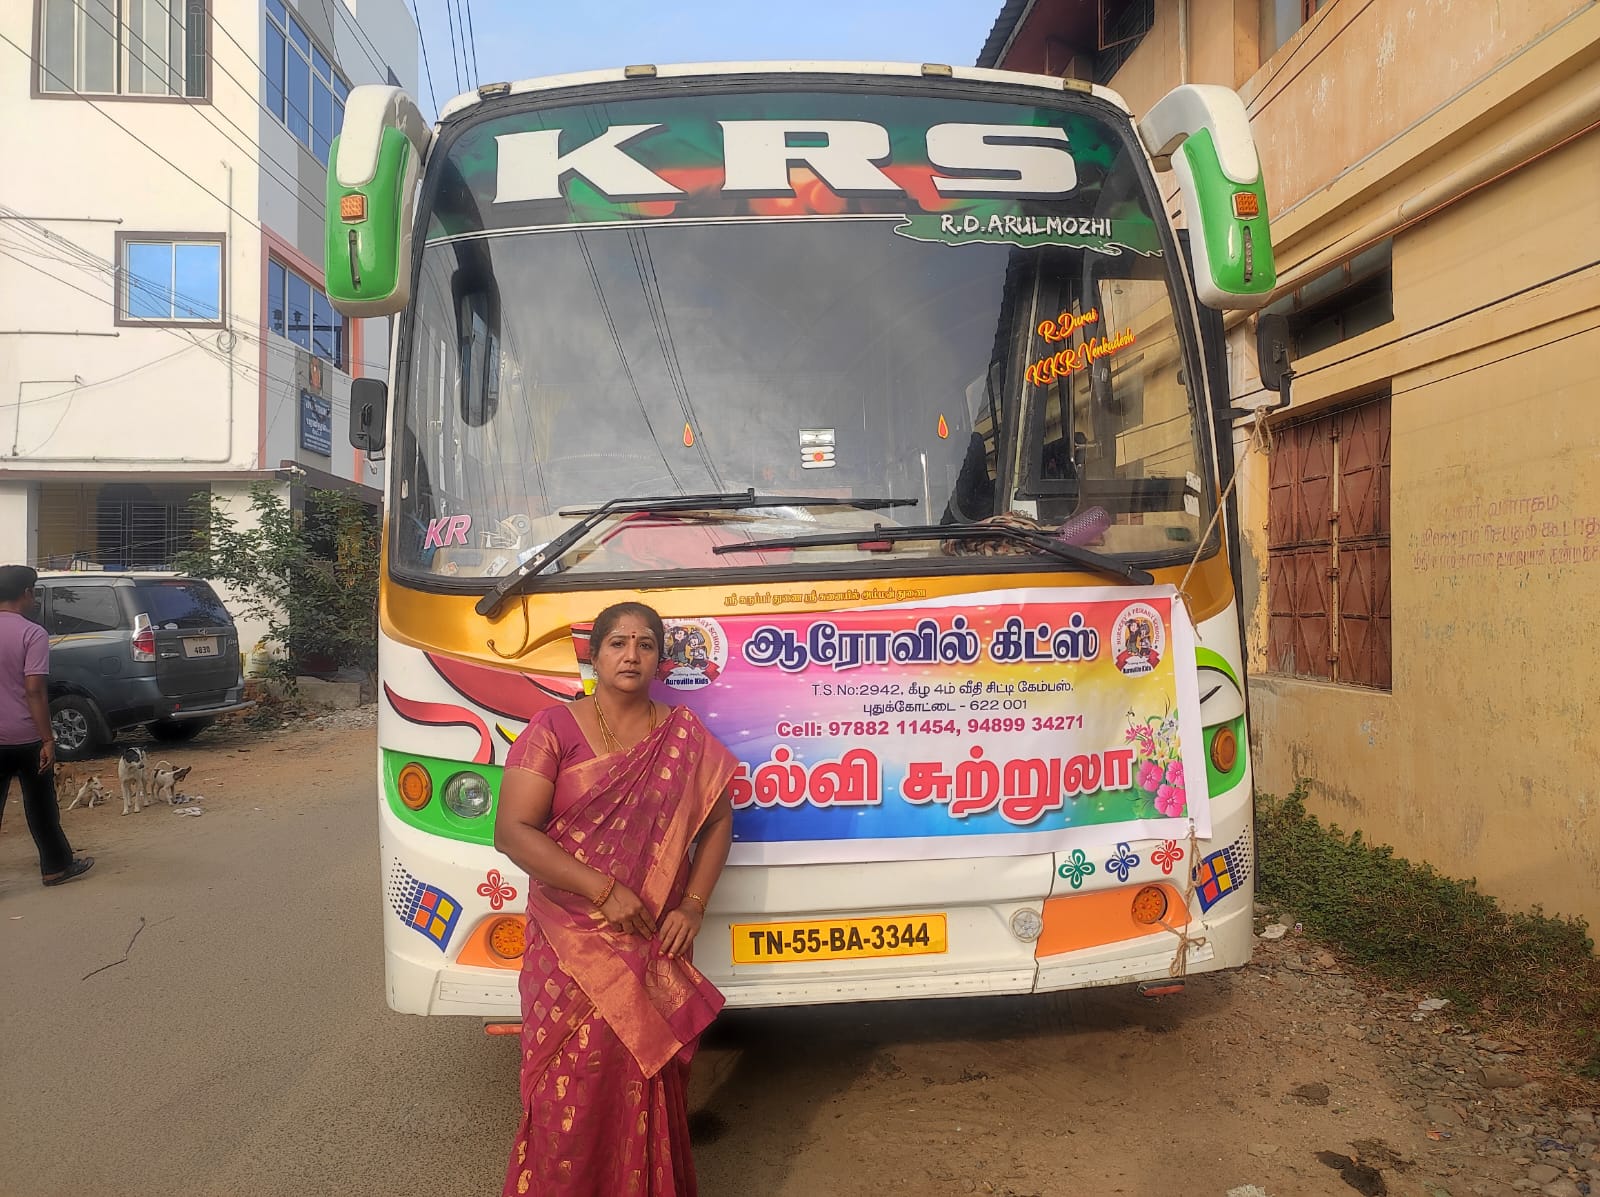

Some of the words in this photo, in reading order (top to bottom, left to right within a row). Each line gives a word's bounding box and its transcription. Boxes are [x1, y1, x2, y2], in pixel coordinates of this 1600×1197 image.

[492, 119, 1079, 204] KRS
[941, 214, 1112, 238] R.D.ARULMOZHI
[424, 514, 472, 550] KR
[745, 617, 978, 669] ஆரோவில்
[991, 615, 1098, 660] கிட்ஸ்
[934, 682, 956, 695] 4ம்
[960, 680, 983, 697] வீதி
[986, 680, 1014, 696] சிட்டி
[863, 700, 956, 717] புதுக்கோட்டை
[970, 700, 999, 711] 622
[1003, 699, 1027, 710] 001
[777, 721, 822, 737] Cell:
[828, 721, 889, 736] 97882
[896, 719, 961, 737] 11454,
[967, 718, 1026, 733] 94899
[1032, 715, 1083, 732] 34271
[902, 745, 1133, 821] சுற்றுலா
[749, 922, 930, 956] TN-55-BA-3344
